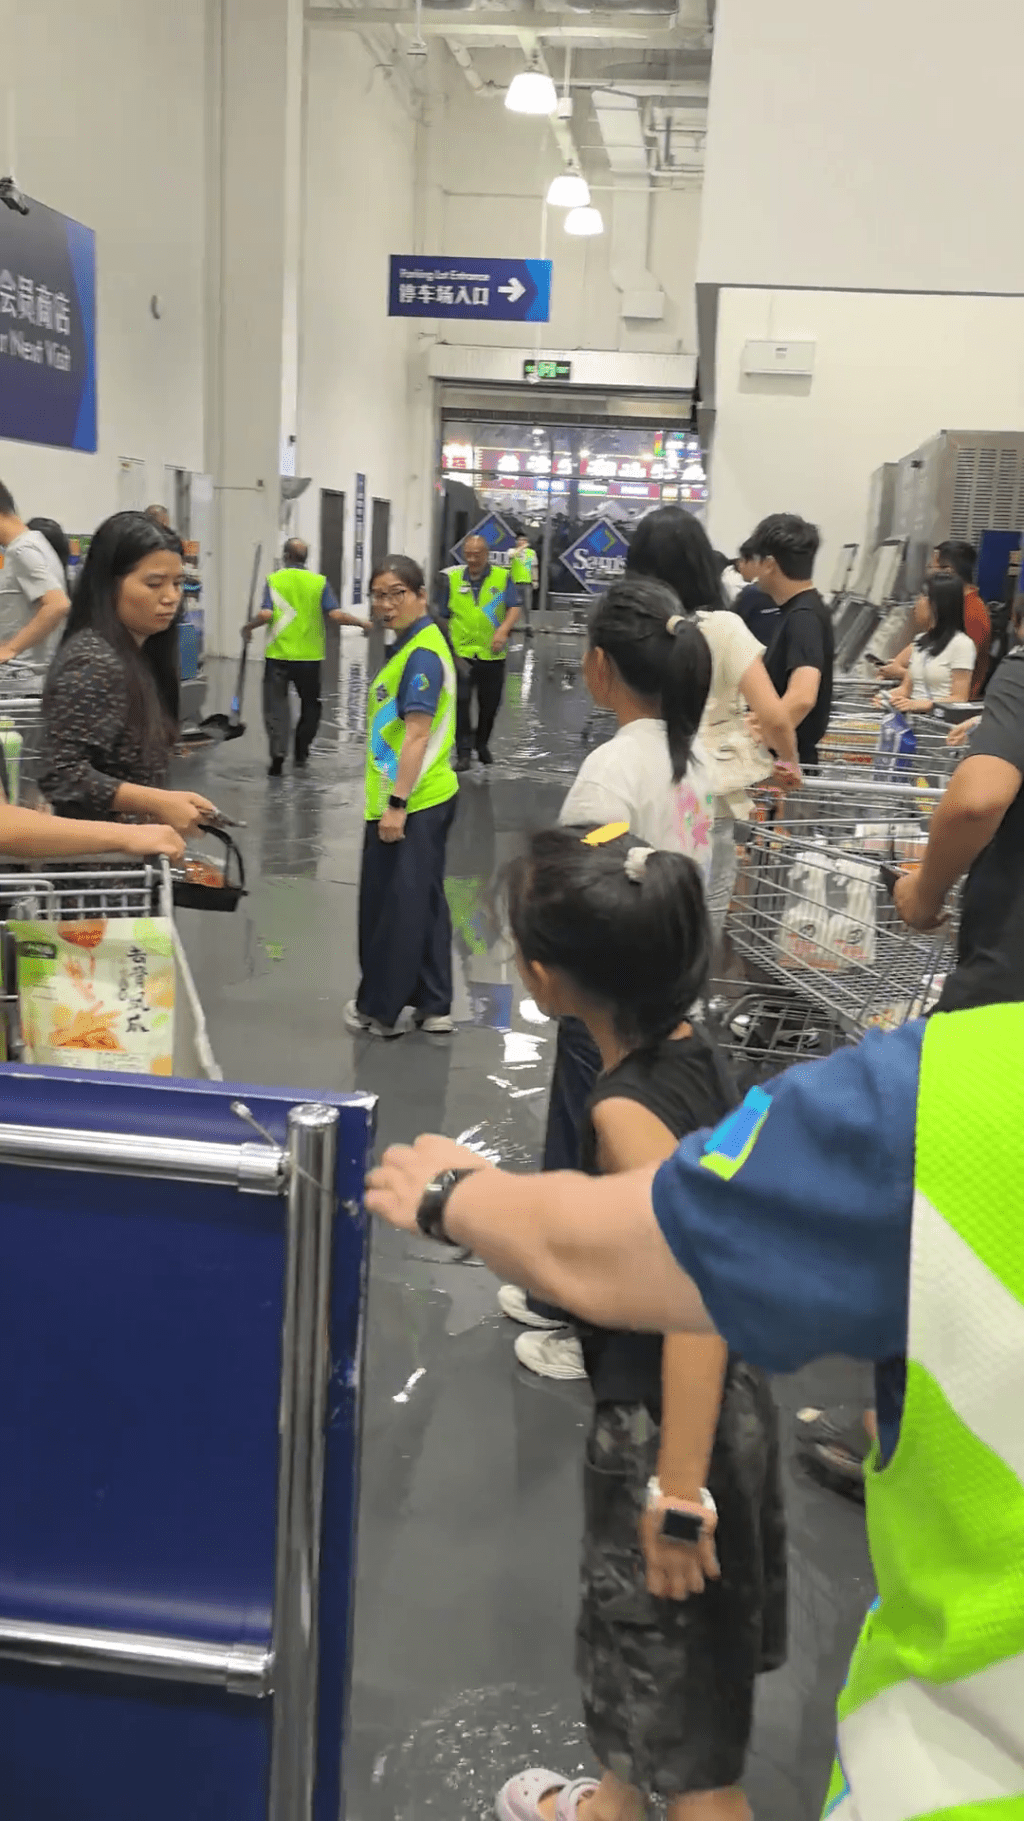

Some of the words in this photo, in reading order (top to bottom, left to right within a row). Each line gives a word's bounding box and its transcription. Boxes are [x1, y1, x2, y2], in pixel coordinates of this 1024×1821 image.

[399, 268, 434, 281] Parking
[434, 269, 449, 280] Lot
[449, 269, 491, 281] Entrance
[0, 269, 71, 336] 会员商店
[399, 283, 490, 306] 停车场入口
